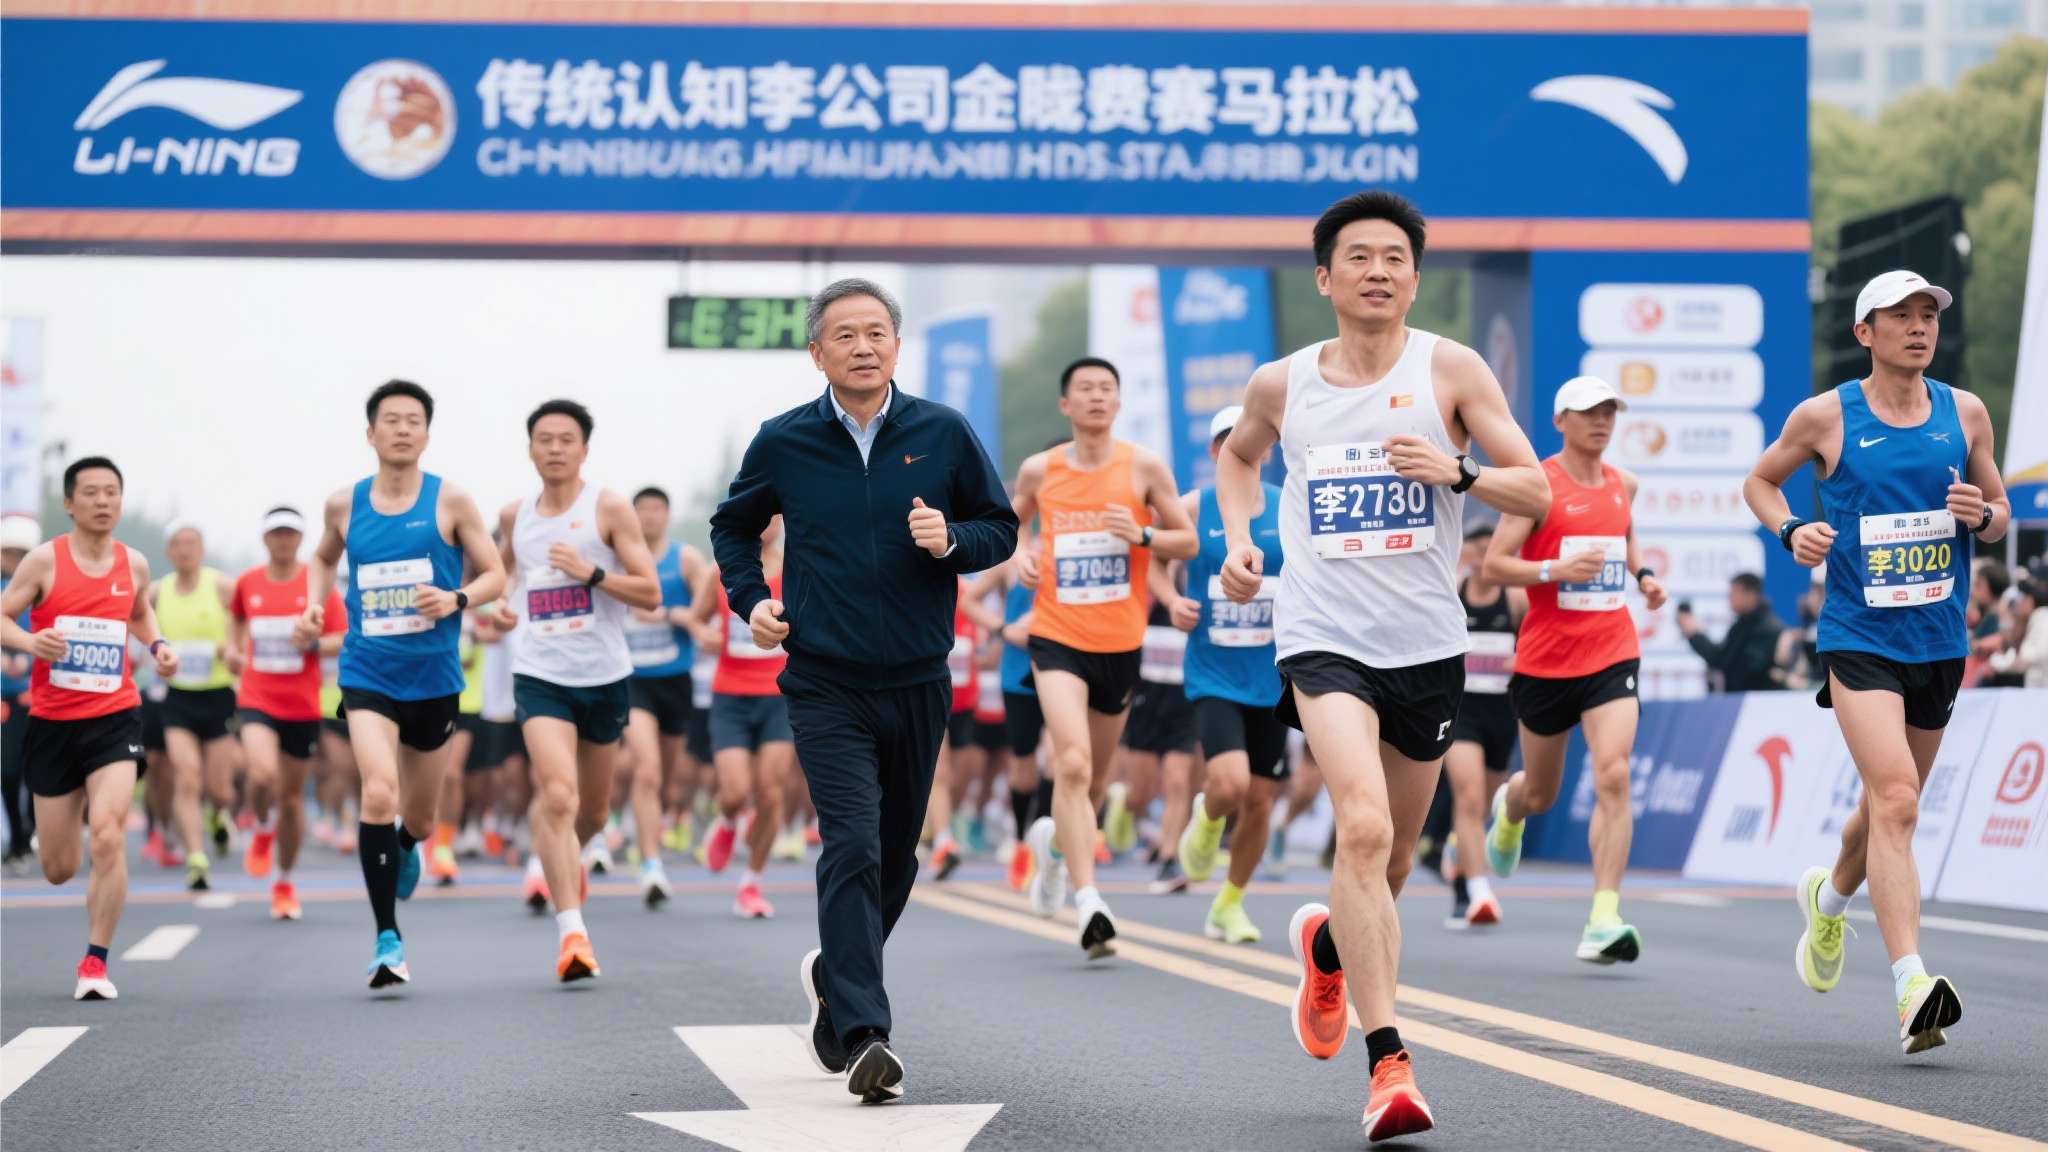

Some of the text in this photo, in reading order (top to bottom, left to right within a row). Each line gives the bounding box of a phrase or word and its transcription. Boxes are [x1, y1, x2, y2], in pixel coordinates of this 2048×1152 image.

[73, 136, 300, 177] LI-NING
[1313, 480, 1427, 523] 李2730
[1867, 543, 1952, 577] 李3020
